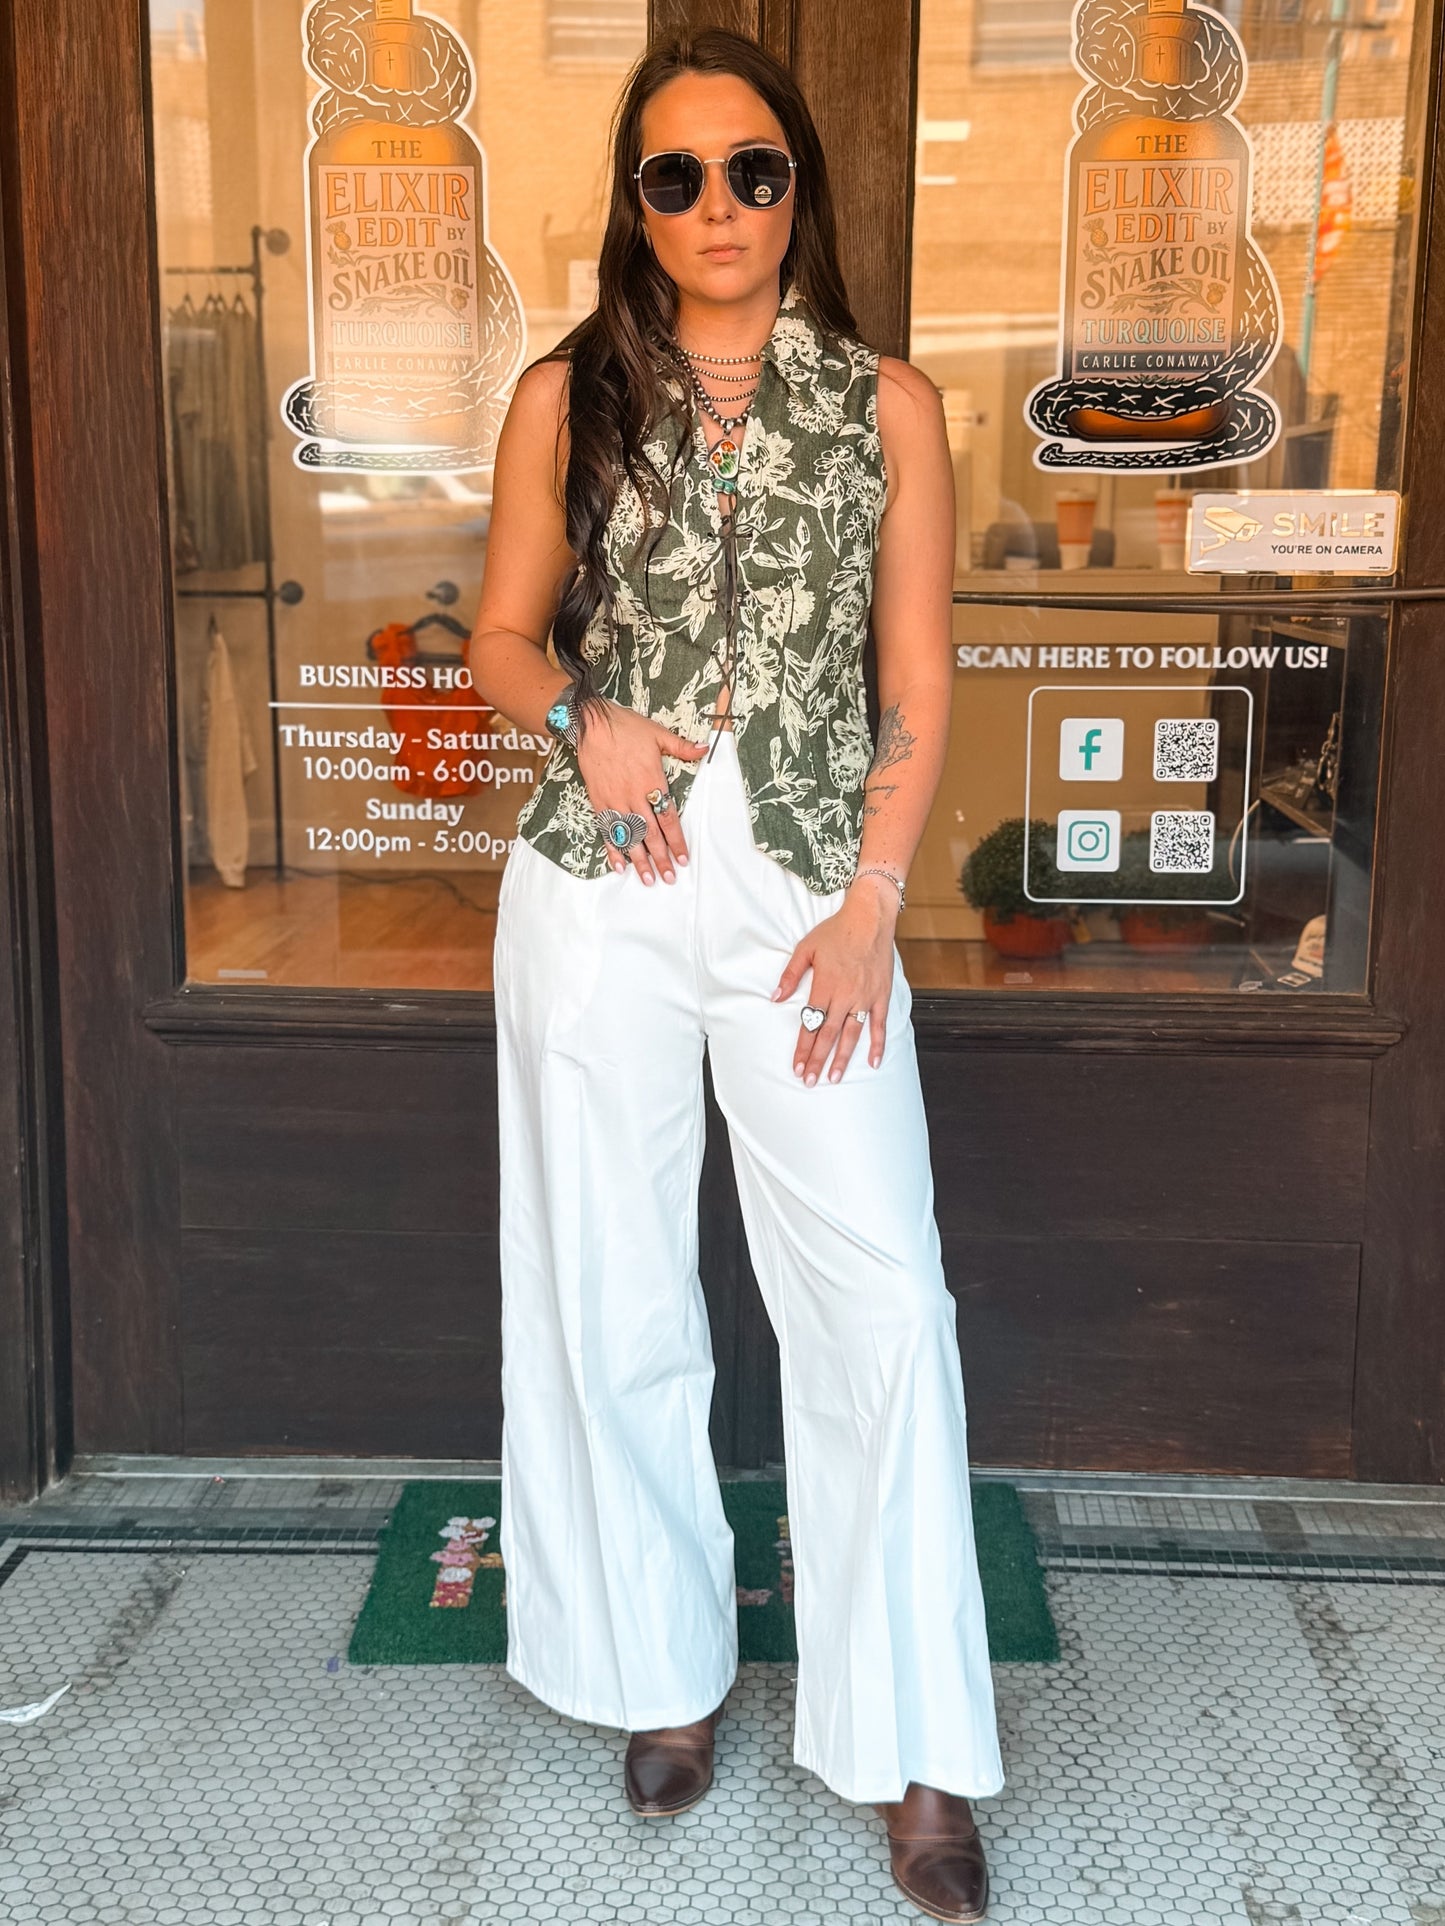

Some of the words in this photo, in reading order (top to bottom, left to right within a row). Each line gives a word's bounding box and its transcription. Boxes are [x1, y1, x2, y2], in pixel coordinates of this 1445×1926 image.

[372, 140, 422, 159] THE
[1136, 135, 1188, 154] THE
[325, 172, 470, 222] ELIXIR
[1083, 167, 1234, 217] ELIXIR
[357, 217, 442, 248] EDIT
[447, 227, 466, 241] BY
[1115, 213, 1202, 244] EDIT
[1207, 222, 1227, 235] BY
[328, 251, 428, 312] SNAKE
[433, 250, 474, 289] OIL
[1080, 247, 1184, 310] SNAKE
[1191, 245, 1232, 285] OIL
[331, 320, 473, 349] TURQUOISE
[1081, 317, 1226, 344] TURQUOISE
[335, 357, 387, 371] CARLIE
[396, 357, 469, 374] CONAWAY
[1082, 355, 1137, 368] CARLIE
[1146, 354, 1221, 368] CONAWAY
[1271, 512, 1385, 538] SMILE
[1271, 545, 1312, 555] YOU'RE
[1316, 545, 1332, 555] ON
[1335, 545, 1383, 555] CAMERA
[957, 646, 1031, 668] SCAN
[1038, 646, 1111, 669] HERE
[1116, 647, 1154, 669] TO
[1160, 647, 1279, 669] FOLLOW
[1285, 647, 1329, 669] US!
[300, 665, 427, 689] BUSINESS
[279, 724, 406, 754] Thursday
[426, 728, 553, 756] Saturday
[303, 757, 411, 781] 10:00am
[432, 760, 534, 789] 6:00pm
[366, 798, 465, 827] Sunday
[306, 827, 411, 858] 12:00pm
